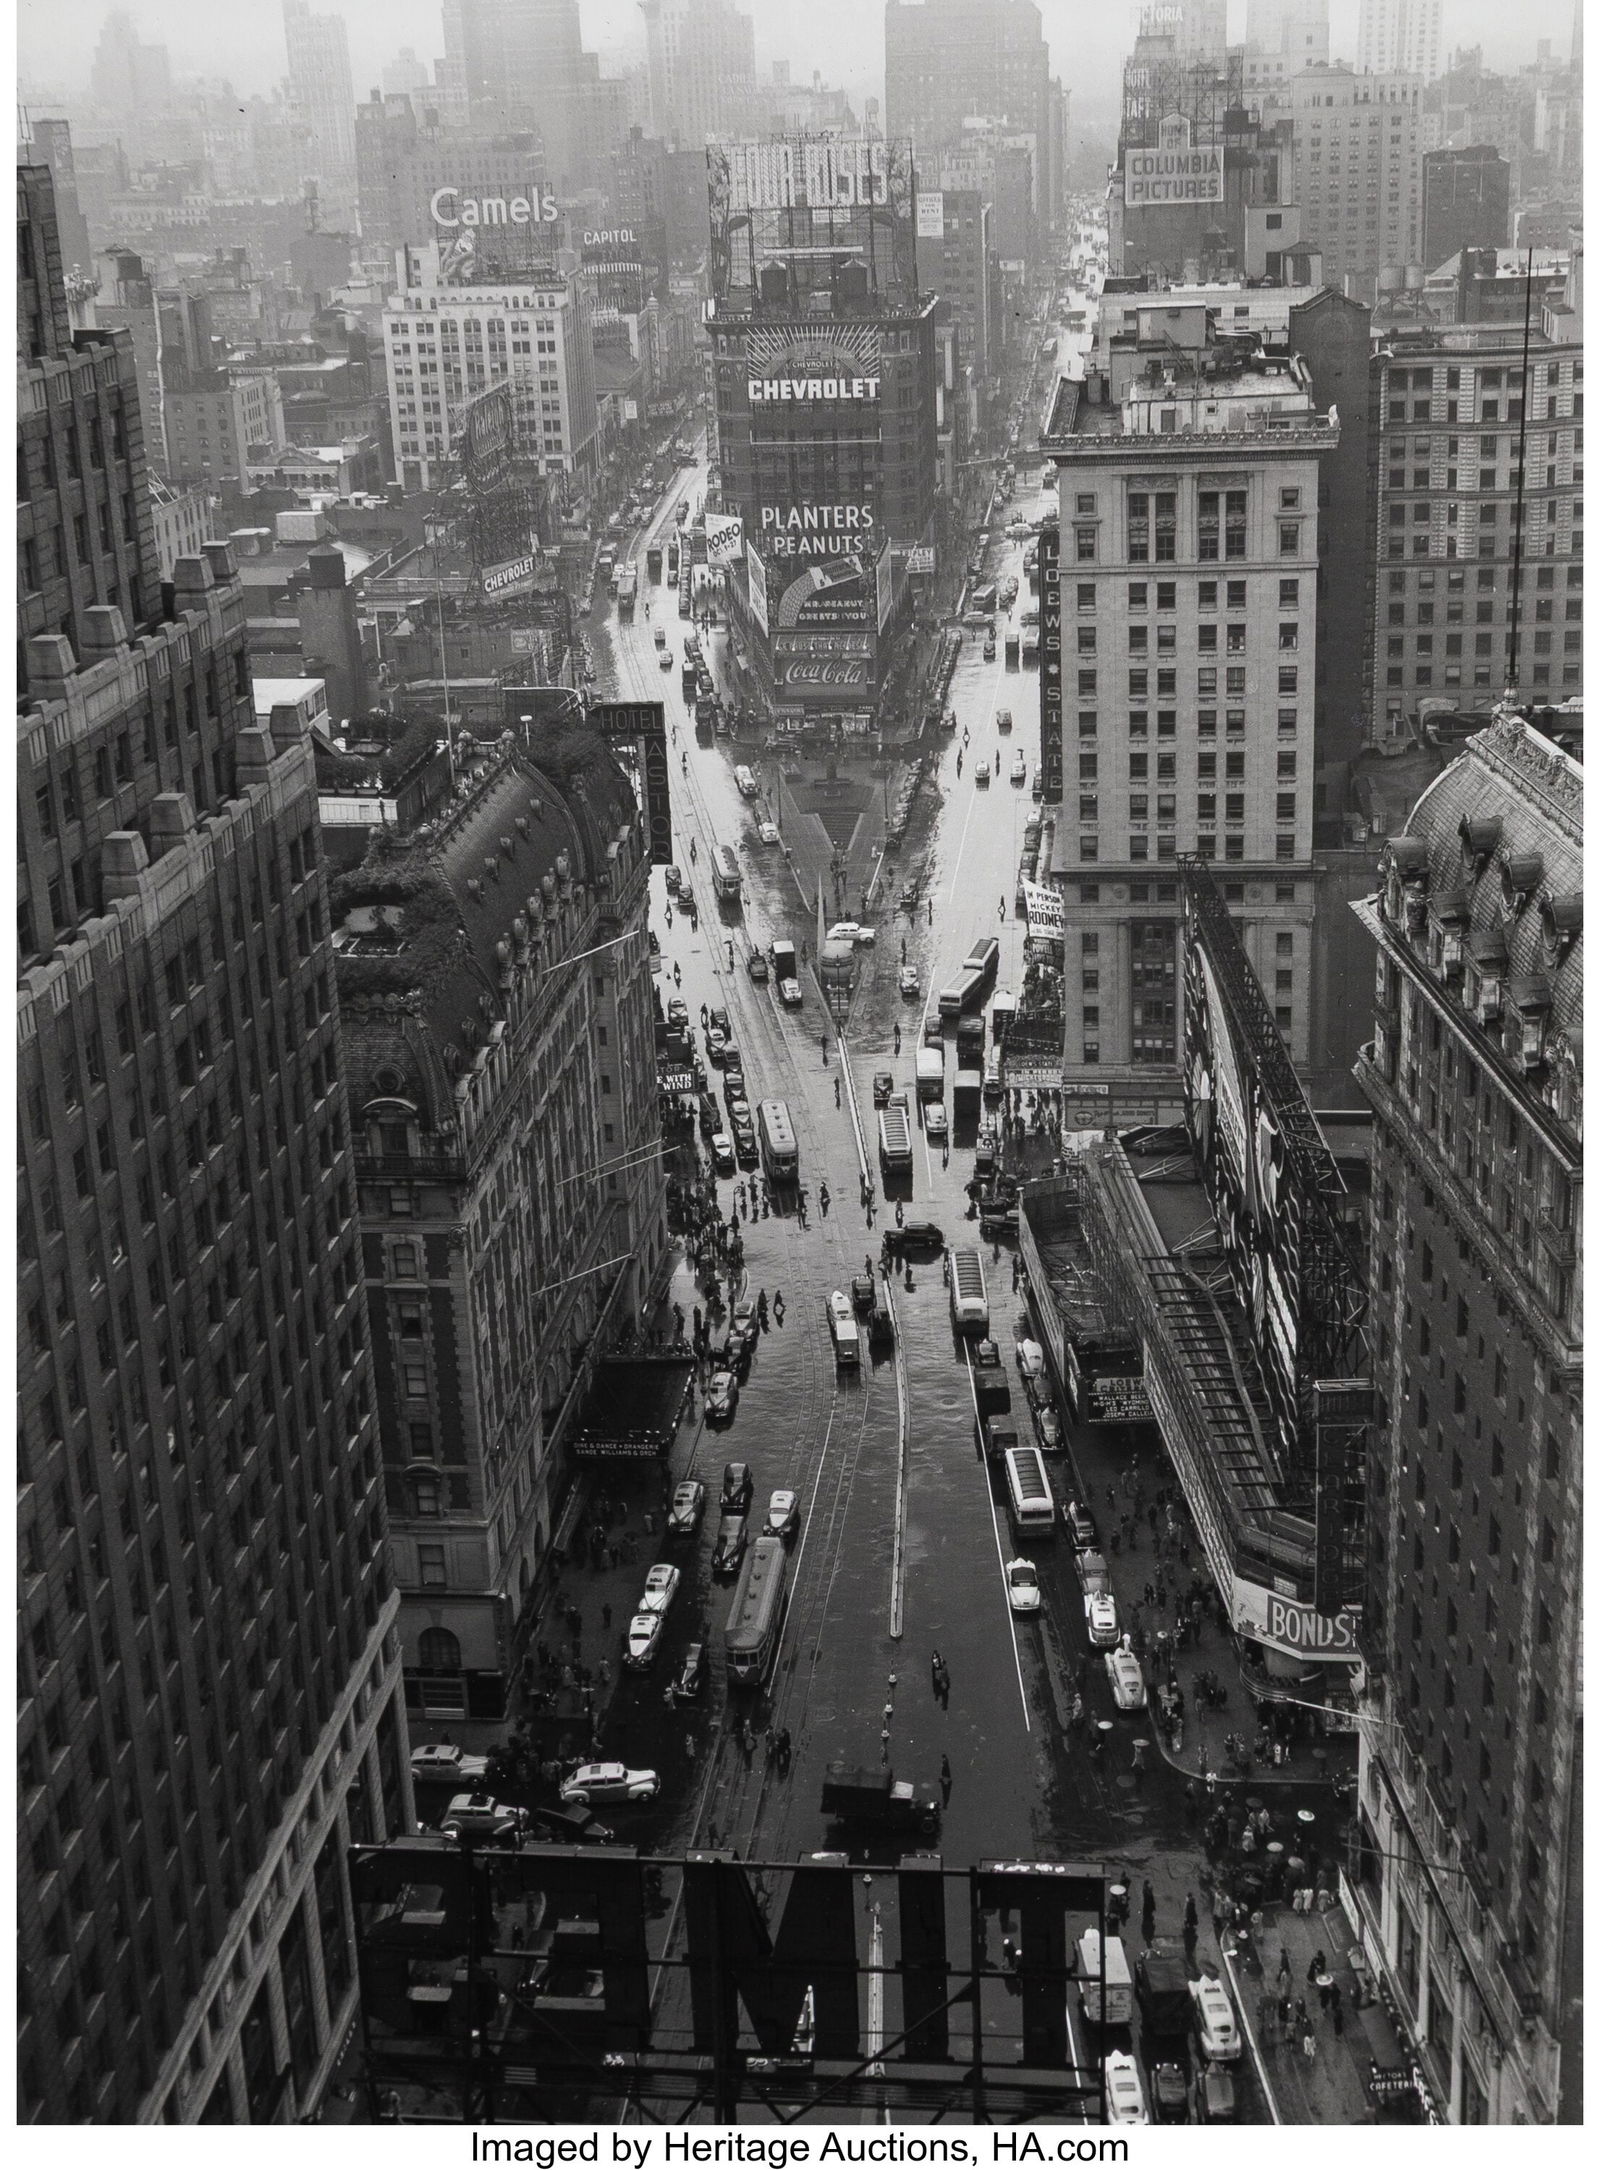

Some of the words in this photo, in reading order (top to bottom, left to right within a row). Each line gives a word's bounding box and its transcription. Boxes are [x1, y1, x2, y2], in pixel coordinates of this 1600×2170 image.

[1131, 155, 1220, 175] COLUMBIA
[1132, 179, 1219, 200] PICTURES
[430, 186, 559, 227] Camels
[583, 229, 638, 246] CAPITOL
[791, 360, 834, 369] CHEVROLET
[748, 377, 881, 400] CHEVROLET
[761, 505, 874, 531] PLANTERS
[707, 522, 742, 552] RODEO
[774, 533, 864, 556] PEANUTS
[484, 556, 535, 594] CHEVROLET
[845, 612, 867, 621] YOU
[601, 710, 662, 729] HOTEL
[1047, 686, 1062, 789] STATE
[647, 741, 671, 860] ASTOR
[1030, 903, 1061, 913] MICKEY
[1036, 892, 1061, 904] PERSON
[1029, 909, 1064, 929] ROONEY
[663, 1082, 692, 1091] WIND
[666, 1073, 692, 1083] WITH
